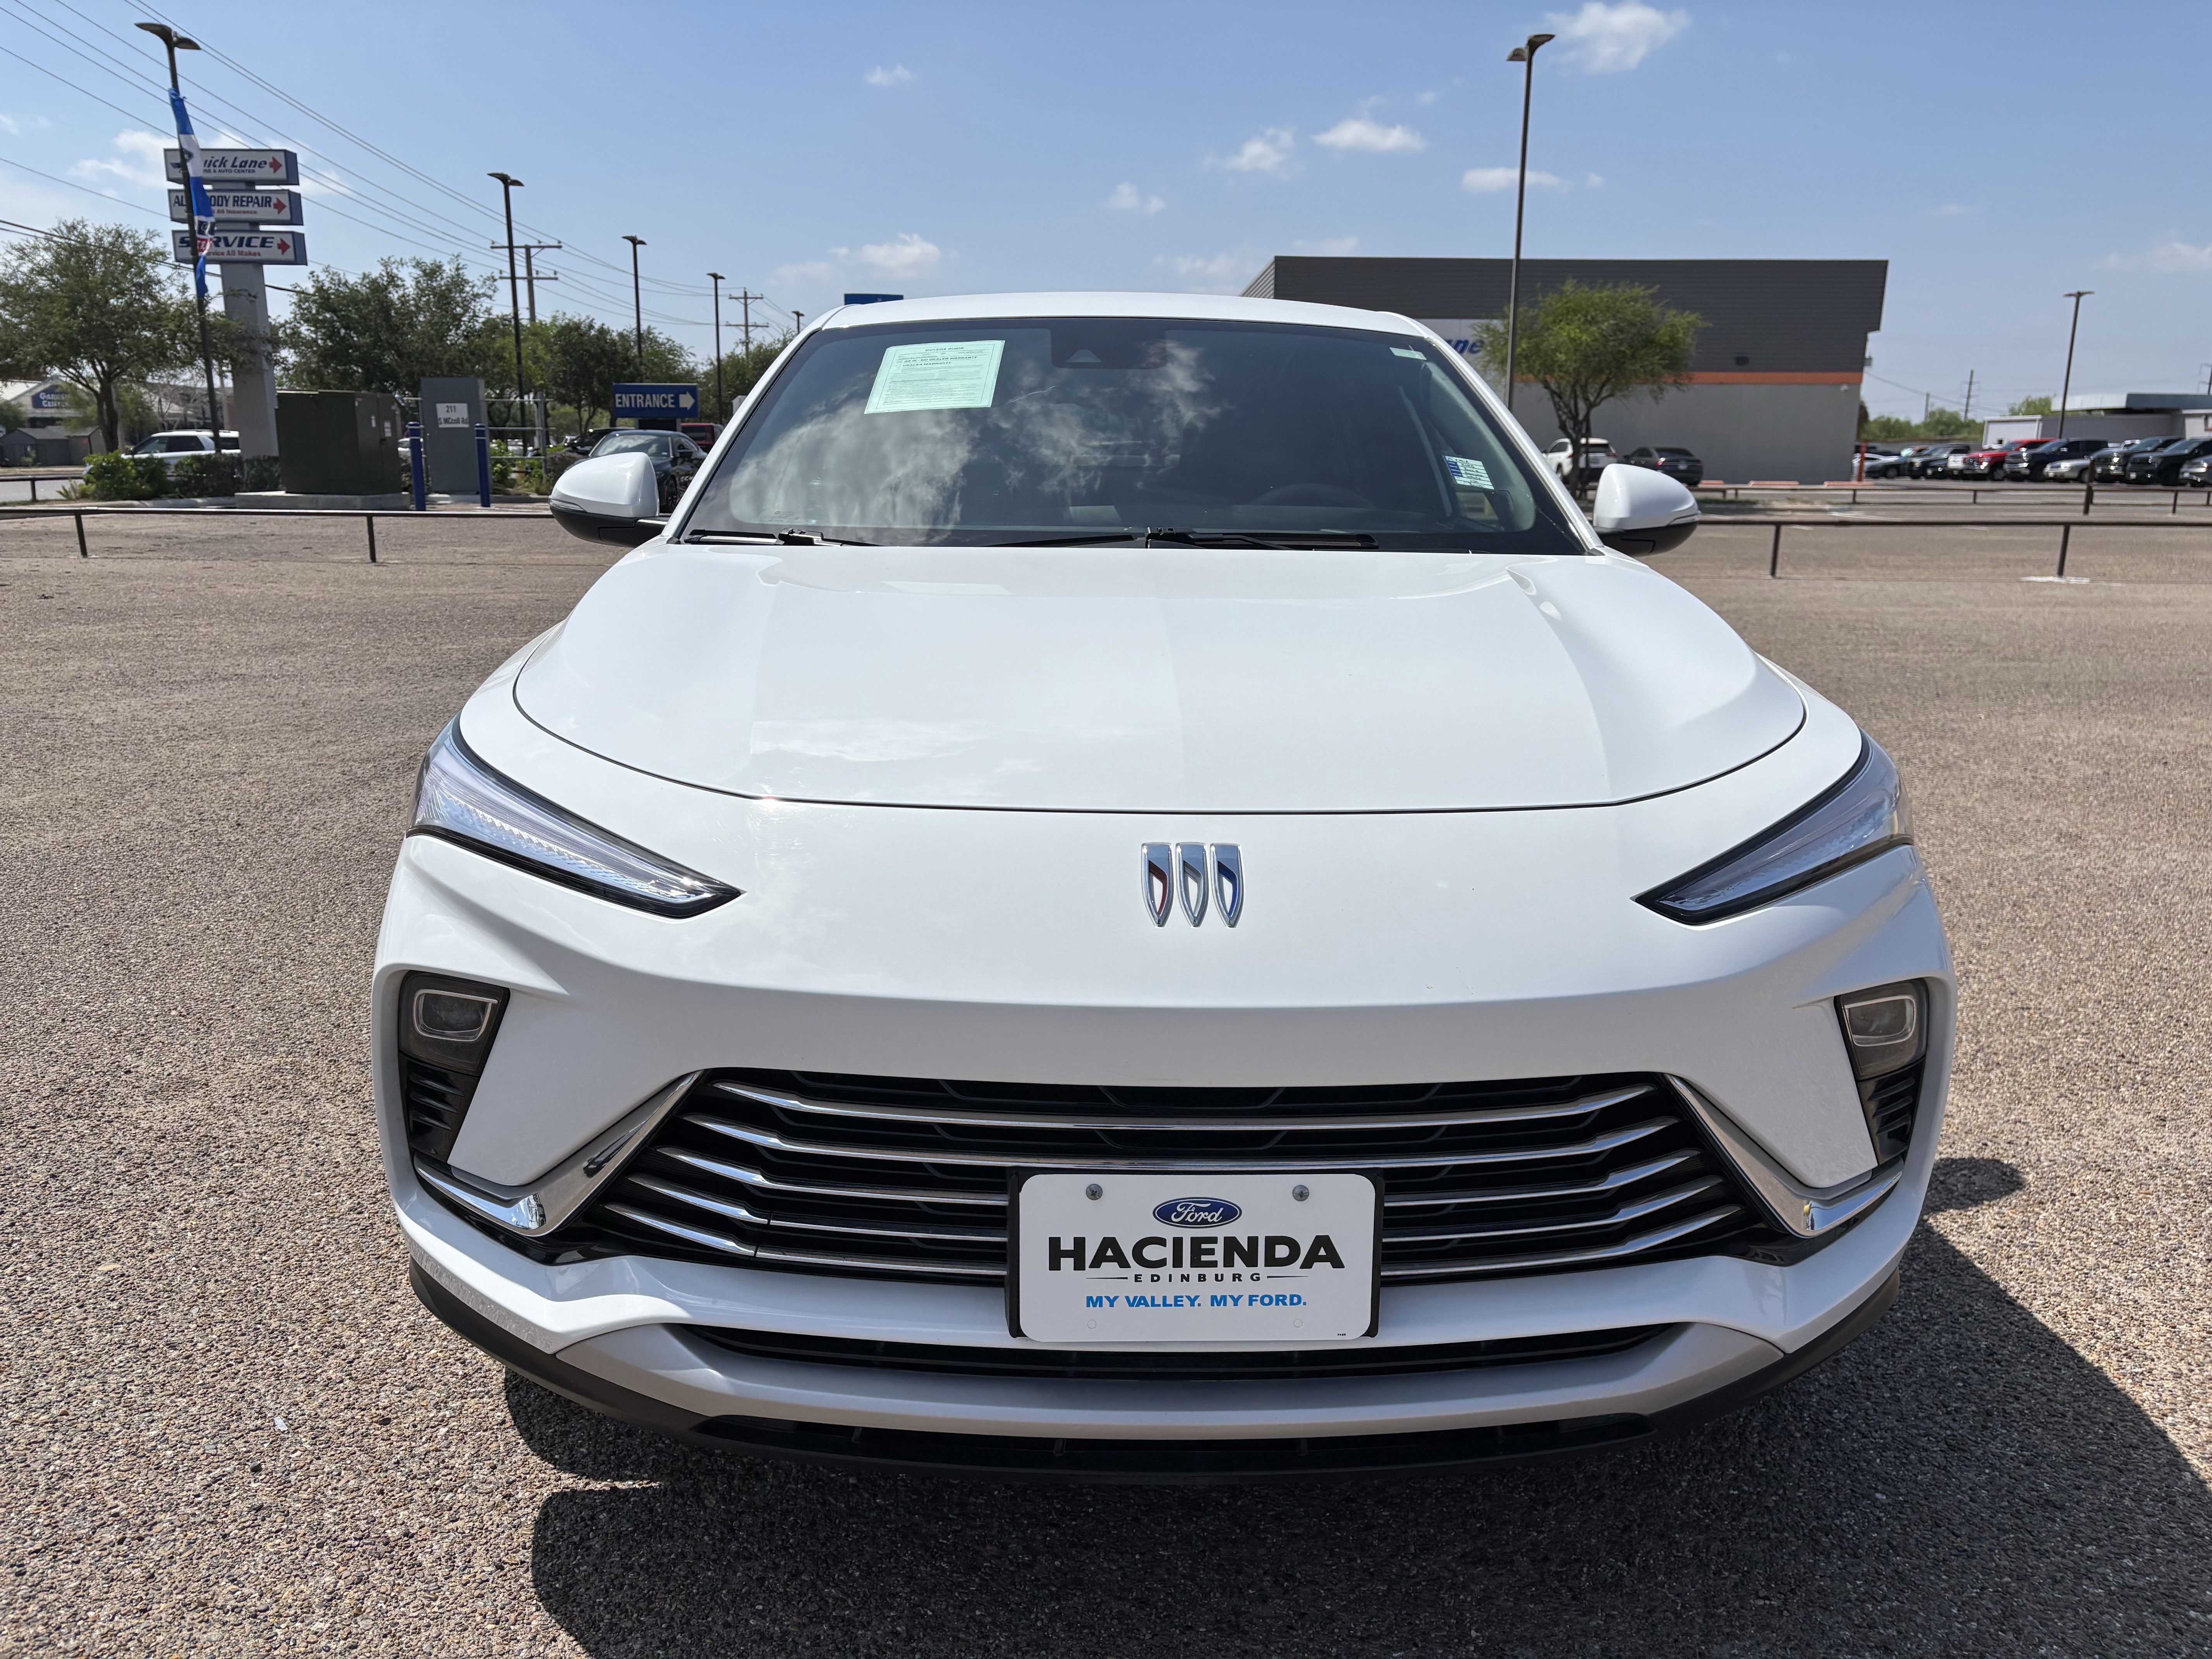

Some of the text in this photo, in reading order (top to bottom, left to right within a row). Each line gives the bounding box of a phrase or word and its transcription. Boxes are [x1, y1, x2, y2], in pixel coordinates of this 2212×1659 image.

[230, 156, 267, 168] Lane
[173, 195, 272, 207] AL ODY REPAIR
[178, 236, 275, 248] SRVICE
[615, 393, 675, 408] ENTRANCE
[1171, 1202, 1224, 1223] Ford
[1048, 1235, 1345, 1271] HACIENDA
[1134, 1273, 1261, 1283] EDINBURG
[1086, 1294, 1307, 1308] MY VALLEY. MY FORD.
